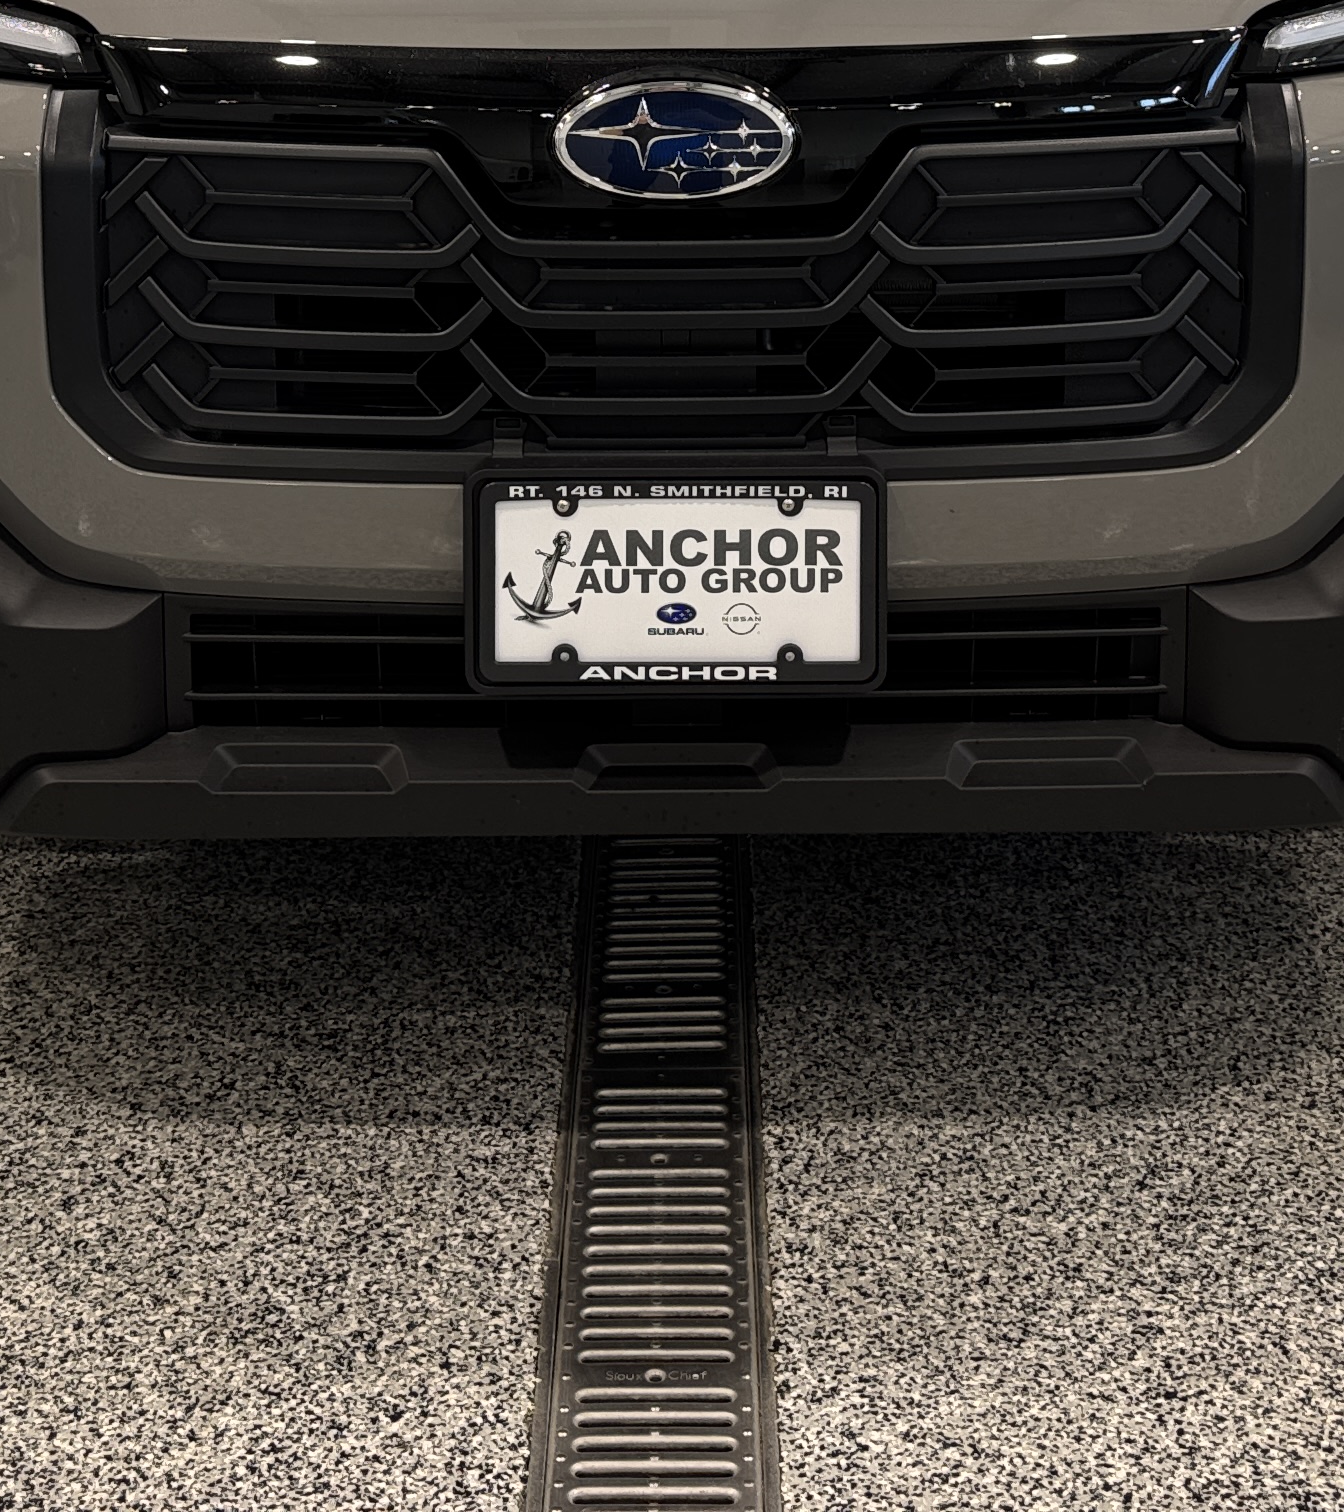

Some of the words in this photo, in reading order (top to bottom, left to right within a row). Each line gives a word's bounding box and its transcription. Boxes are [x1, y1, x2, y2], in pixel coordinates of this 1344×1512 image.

[508, 485, 544, 498] RT.
[556, 485, 603, 498] 146
[613, 485, 640, 498] N.
[650, 485, 813, 499] SMITHFIELD,
[824, 485, 848, 498] RI
[579, 528, 843, 567] ANCHOR
[575, 567, 687, 594] AUTO
[701, 567, 843, 594] GROUP
[647, 627, 705, 636] SUBARU
[579, 666, 777, 681] ANCHOR
[605, 1370, 643, 1381] Sioux
[668, 1370, 708, 1381] Chief
